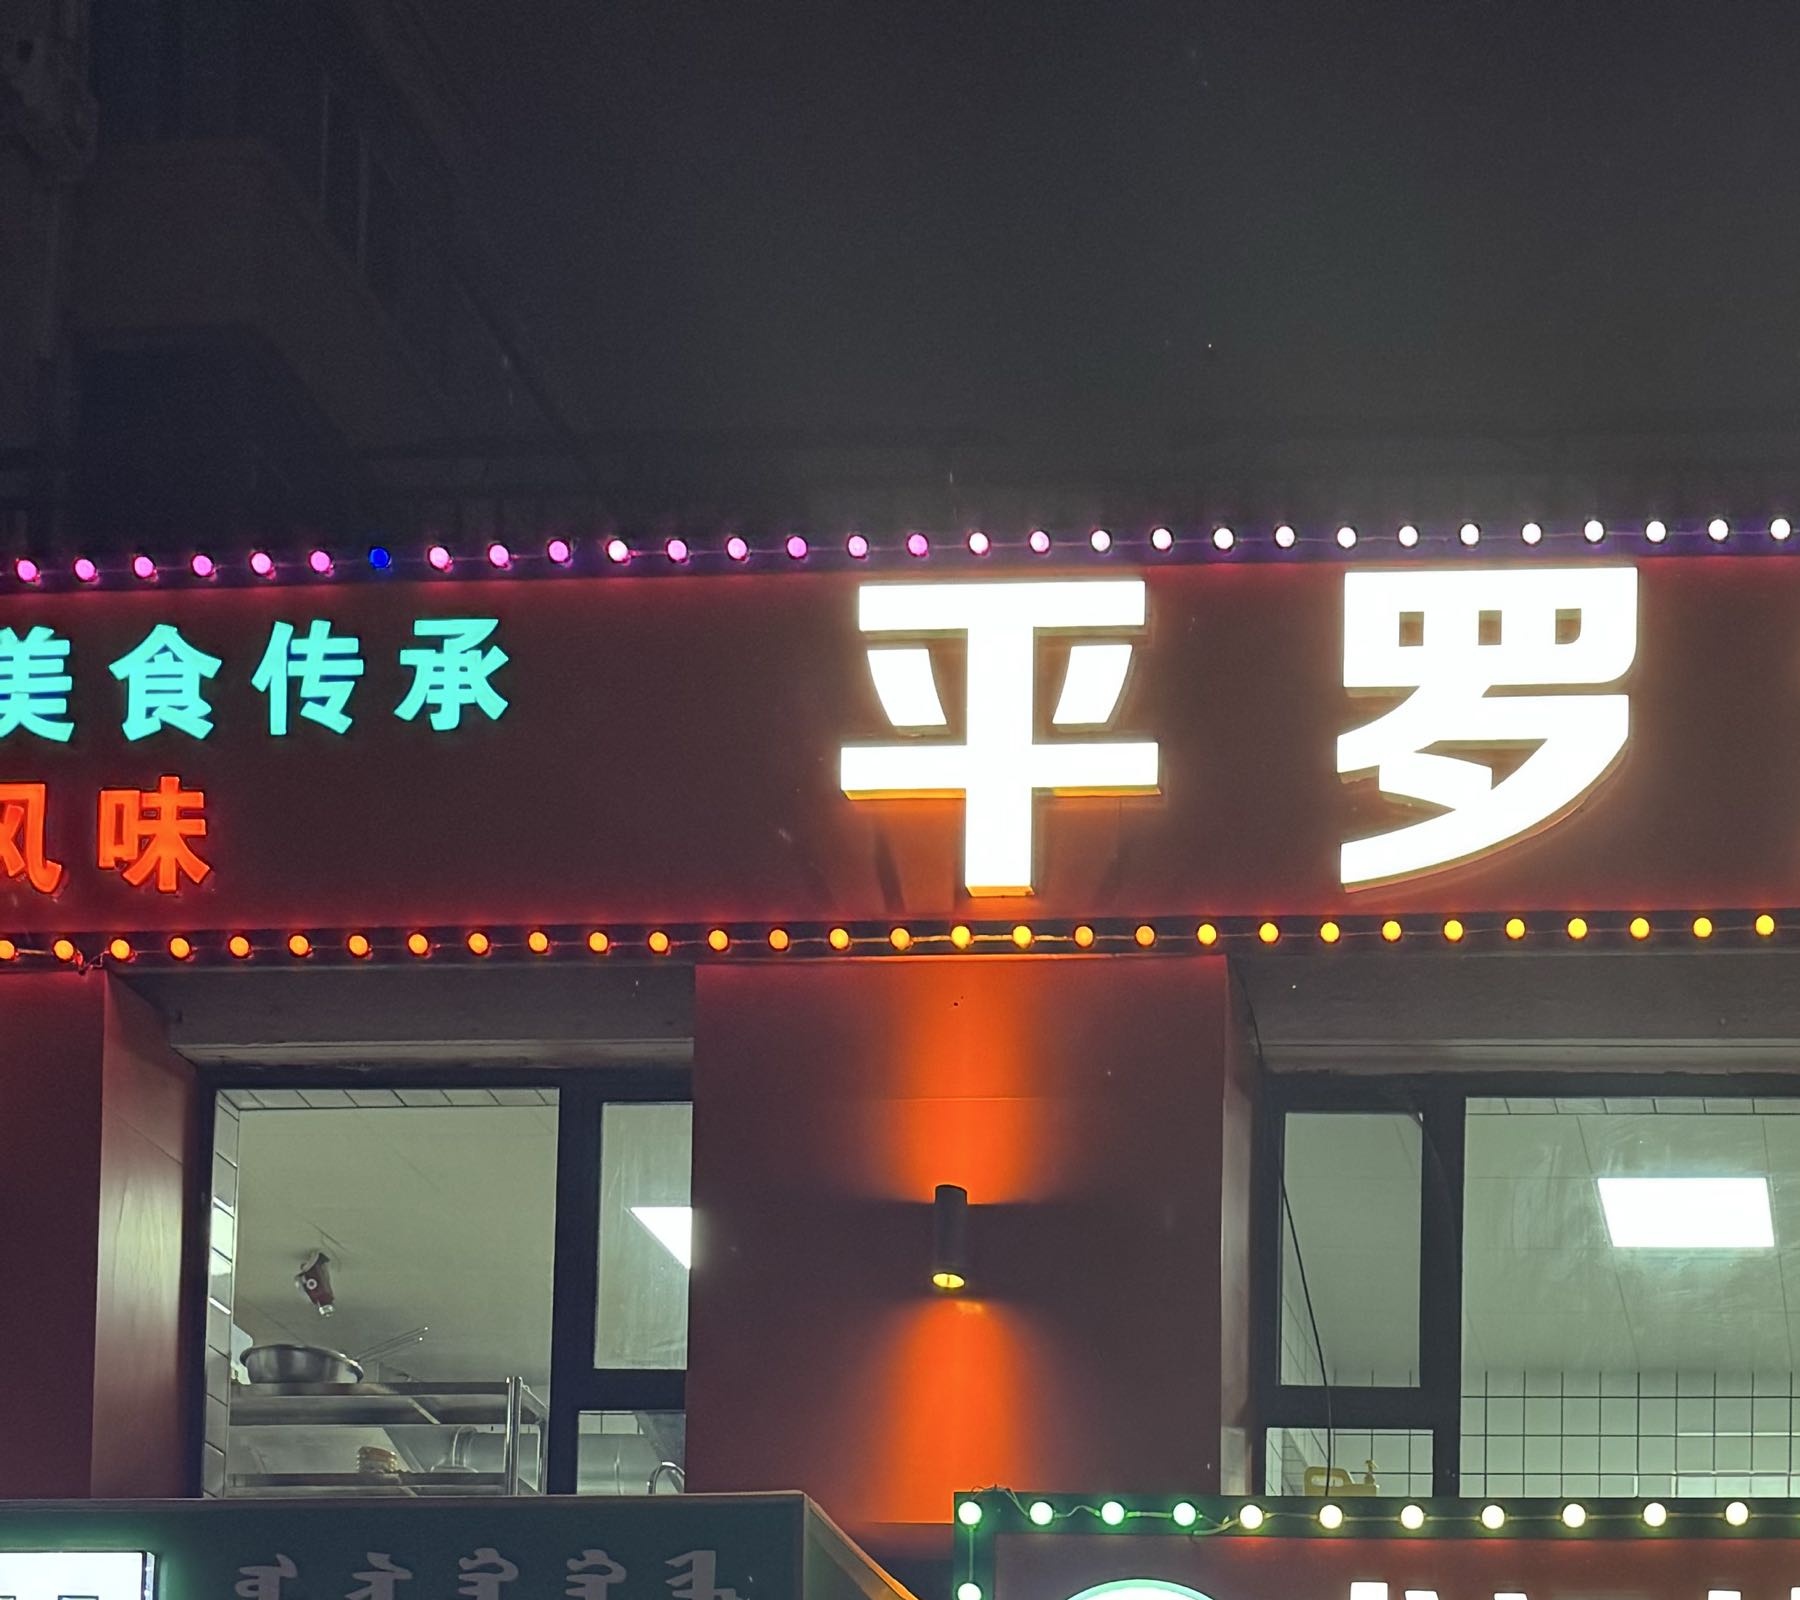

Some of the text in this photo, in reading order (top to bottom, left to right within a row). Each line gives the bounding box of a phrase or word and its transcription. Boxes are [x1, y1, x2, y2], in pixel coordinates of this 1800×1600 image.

[0, 617, 508, 742] 美食传承
[0, 775, 212, 894] 风味
